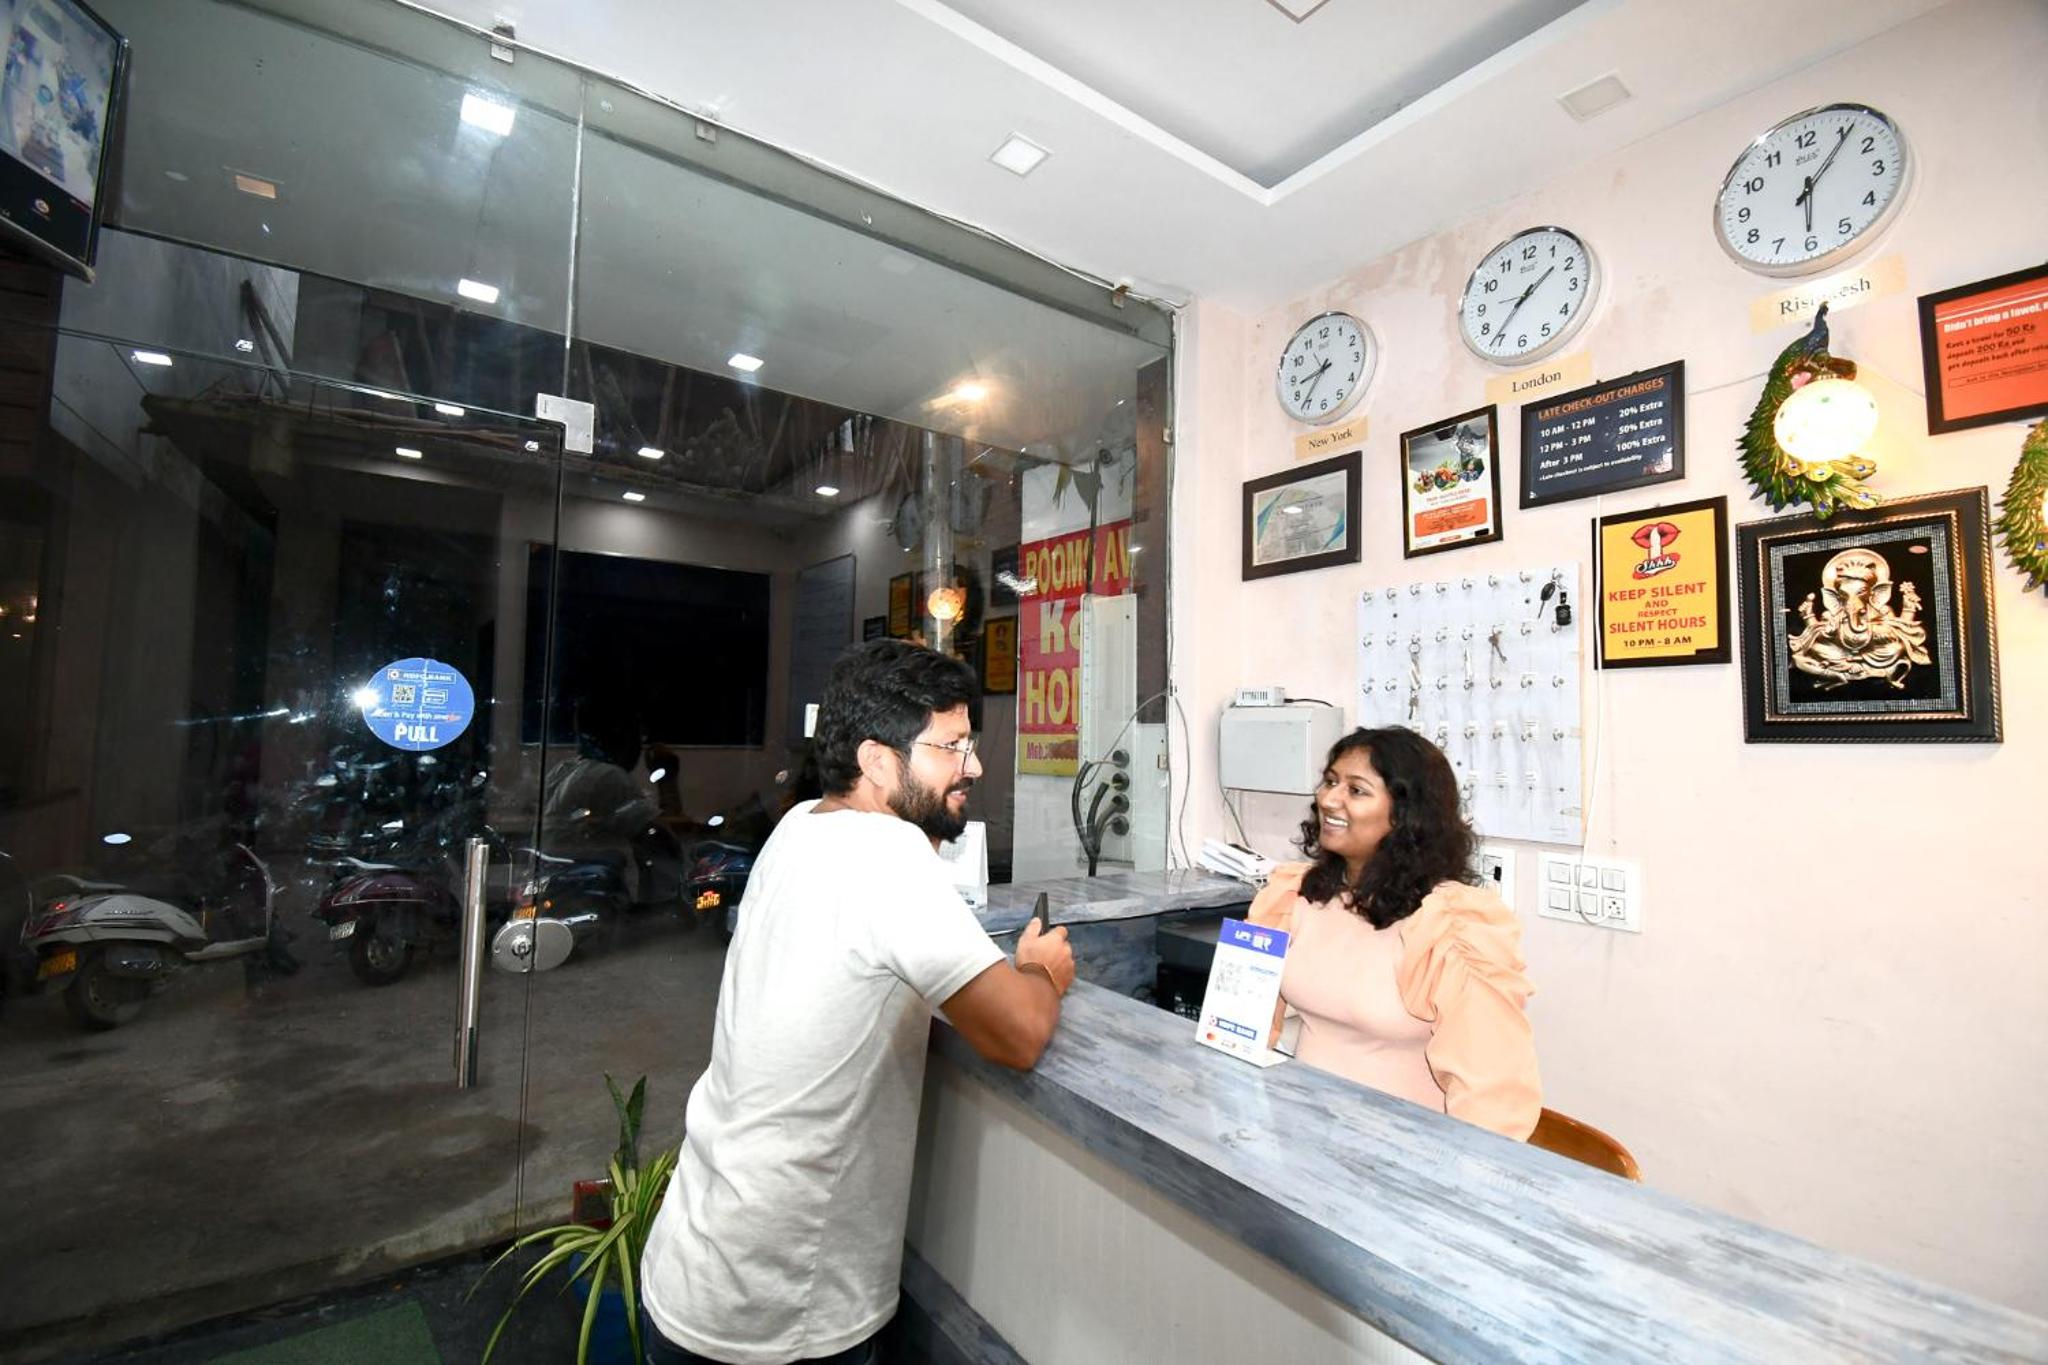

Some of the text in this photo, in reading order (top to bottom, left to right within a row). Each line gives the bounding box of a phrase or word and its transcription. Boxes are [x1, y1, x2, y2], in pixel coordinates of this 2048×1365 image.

[1795, 131, 1816, 149] 12
[1837, 127, 1848, 142] 1
[1861, 137, 1874, 154] 2
[1765, 151, 1781, 168] 11
[1872, 160, 1885, 176] 3
[1743, 177, 1764, 194] 10
[1862, 190, 1876, 205] 4
[1738, 208, 1750, 223] 9
[1839, 218, 1851, 235] 5
[1747, 228, 1759, 244] 8
[1772, 238, 1785, 254] 7
[1805, 236, 1818, 251] 6
[1522, 245, 1537, 260] 12
[1550, 245, 1556, 258] 1
[1500, 260, 1512, 273] 11
[1564, 257, 1574, 271] 2
[1484, 279, 1498, 293] 10
[1569, 278, 1578, 291] 3
[1478, 304, 1486, 317] 9
[1560, 303, 1569, 316] 4
[1320, 327, 1329, 339] 12
[1338, 326, 1343, 336] 1
[1481, 323, 1490, 335] 8
[1541, 323, 1550, 337] 5
[1304, 339, 1313, 350] 11
[1349, 335, 1356, 347] 2
[1498, 333, 1506, 347] 7
[1518, 335, 1527, 347] 6
[1977, 343, 1996, 353] 200
[1294, 355, 1304, 367] 10
[1354, 351, 1360, 362] 3
[1290, 375, 1297, 386] 9
[1348, 372, 1354, 383] 4
[1512, 371, 1562, 392] London
[1294, 391, 1300, 401] 8
[1336, 389, 1343, 400] 5
[1538, 377, 1665, 420] LATE CHECK-OUT CHARGES
[1320, 399, 1327, 410] 6
[1541, 429, 1550, 438] 10
[1552, 425, 1565, 435] AM
[1571, 422, 1582, 431] 12
[1583, 417, 1596, 427] PM
[1619, 406, 1638, 418] 20%
[1640, 400, 1663, 412] Extra
[1308, 428, 1353, 451] New York
[1540, 444, 1549, 453] 12
[1551, 442, 1564, 451] PM
[1571, 438, 1577, 446] 3
[1578, 434, 1592, 444] PM
[1618, 424, 1638, 435] 50%
[1640, 417, 1663, 429] Extra
[1539, 459, 1560, 470] After
[1563, 456, 1569, 465] 3
[1570, 453, 1583, 463] PM
[1616, 440, 1640, 452] 100%
[1642, 434, 1666, 446] Extra
[1609, 582, 1707, 602] KEEP SILENT
[1645, 600, 1669, 608] AND
[1638, 608, 1678, 618] RESPECT
[1609, 616, 1707, 634] SILENT HOURS
[1624, 639, 1636, 647] 10
[1638, 638, 1655, 646] PM
[1664, 637, 1671, 645] 8
[1673, 636, 1692, 645] AM
[395, 724, 439, 742] PULL
